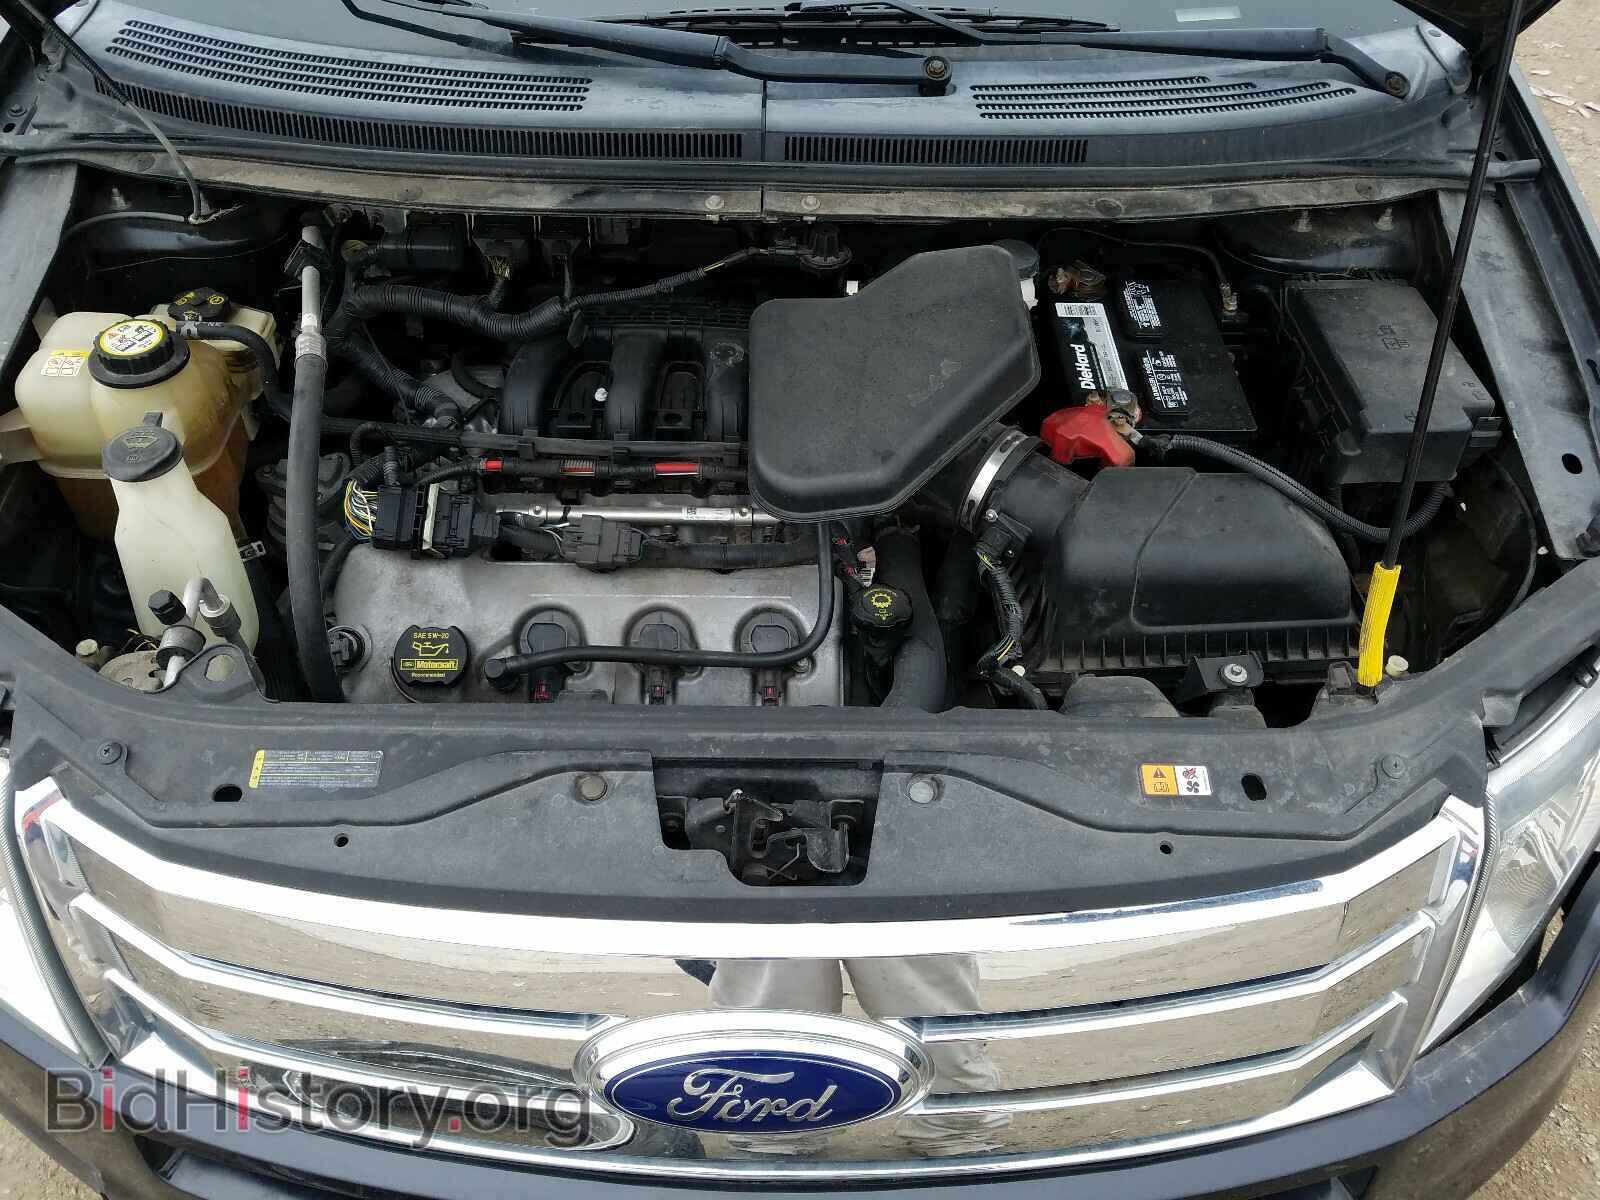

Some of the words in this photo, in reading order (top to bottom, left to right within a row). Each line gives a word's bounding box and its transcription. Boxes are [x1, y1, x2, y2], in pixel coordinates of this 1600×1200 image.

[1070, 343, 1096, 390] DieHard
[416, 660, 456, 669] Motorcraft
[666, 1067, 838, 1122] Ford
